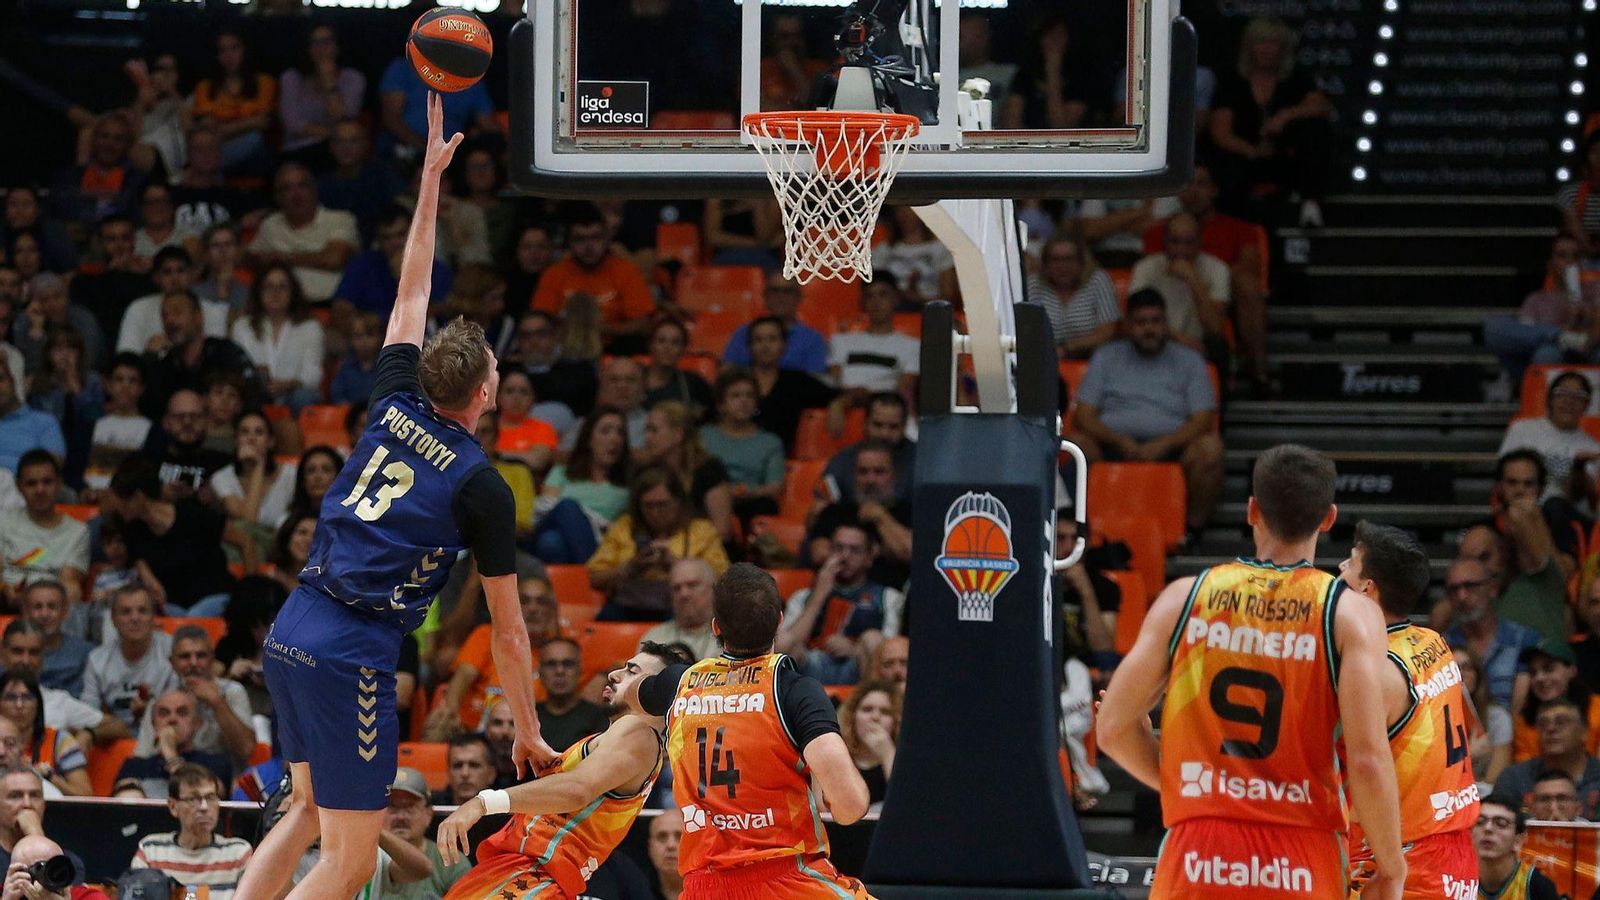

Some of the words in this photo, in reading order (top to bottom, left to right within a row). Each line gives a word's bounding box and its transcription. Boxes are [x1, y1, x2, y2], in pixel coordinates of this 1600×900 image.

[580, 109, 643, 123] endesa
[581, 94, 609, 111] liga
[1339, 364, 1421, 395] Torres
[380, 405, 457, 472] PUSTOVYI
[340, 445, 415, 521] 13
[943, 559, 979, 568] VALENCIA
[982, 560, 1012, 570] BASKET
[1207, 588, 1242, 613] VAN
[1245, 593, 1313, 622] ROSSOM
[268, 637, 288, 654] Costa
[290, 647, 317, 668] Cálida
[1186, 616, 1317, 661] PAMESA
[1414, 661, 1462, 704] PAMES
[673, 693, 765, 718] PAMESA
[1210, 667, 1284, 760] 9
[1444, 704, 1468, 773] 4
[696, 726, 741, 799] 14
[1219, 769, 1313, 804] isaval
